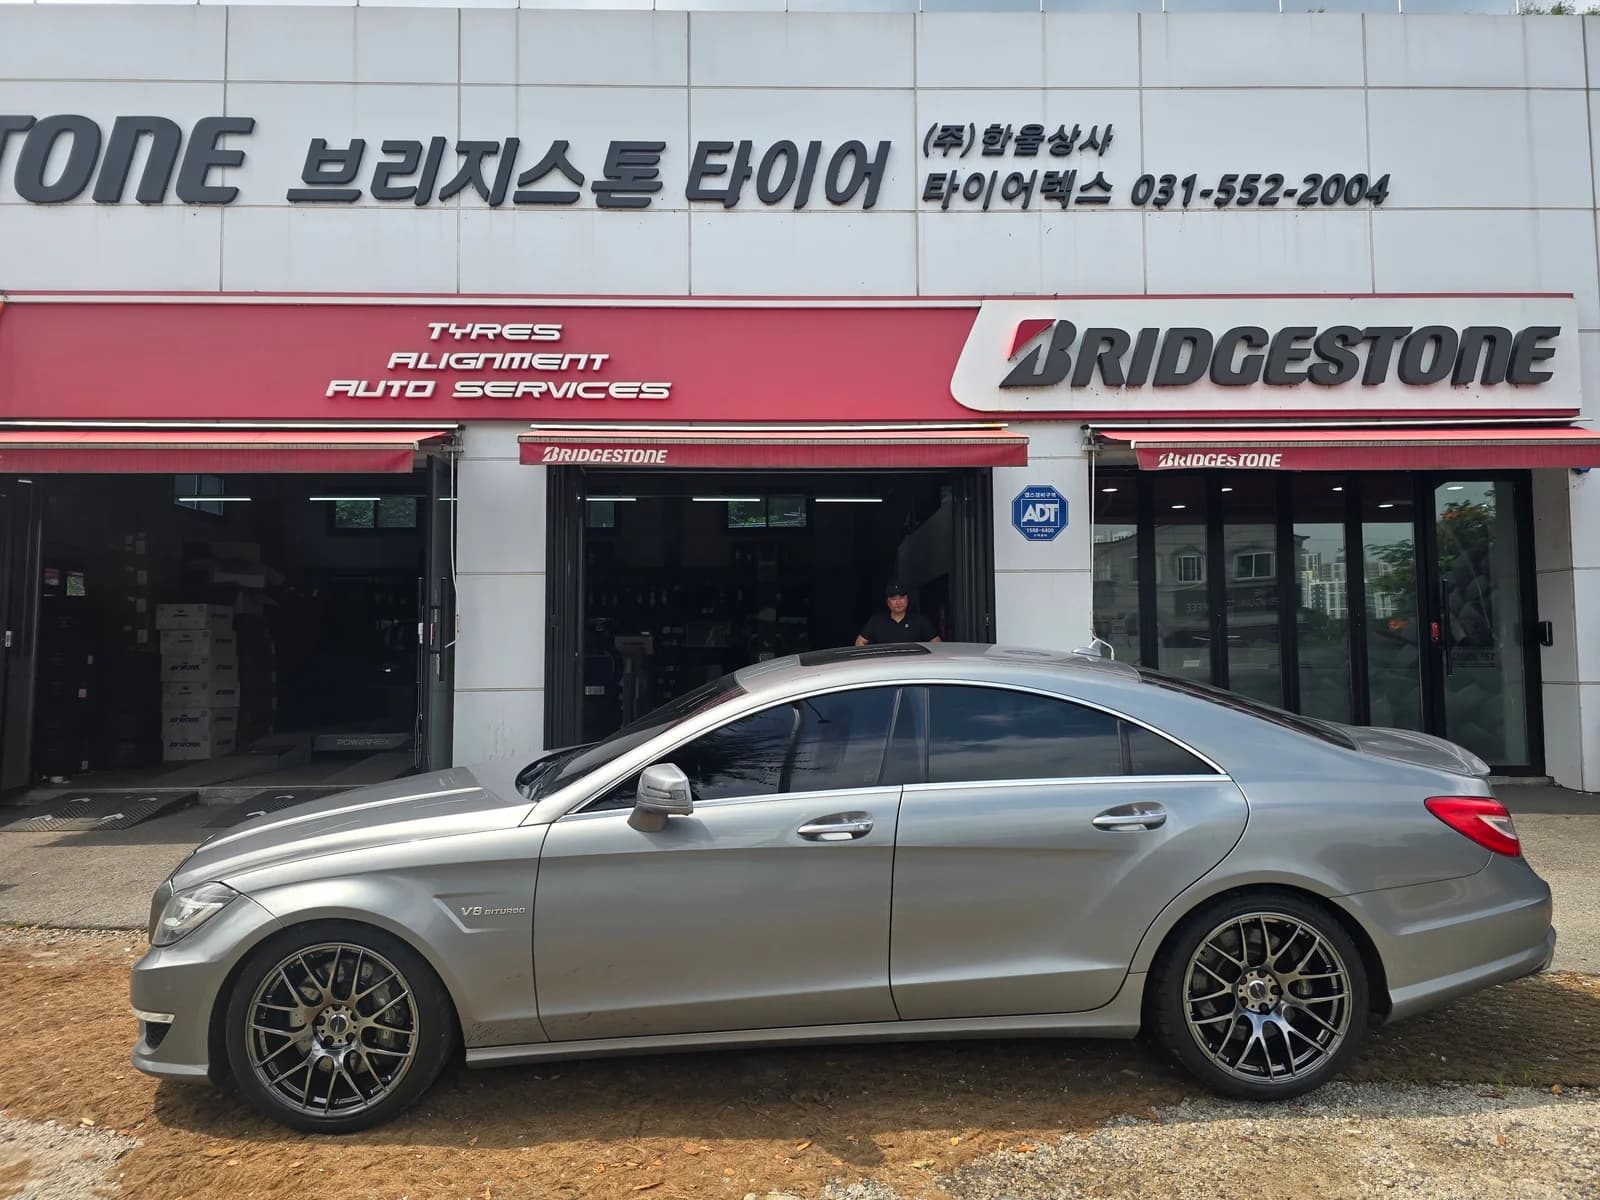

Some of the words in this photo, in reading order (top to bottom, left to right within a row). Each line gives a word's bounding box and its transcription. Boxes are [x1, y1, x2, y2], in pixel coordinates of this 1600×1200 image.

[286, 136, 667, 209] 브리지스톤
[685, 139, 892, 210] 타이어
[922, 168, 1113, 211] 타이어렉스
[1130, 172, 1391, 209] 031-552-2004
[427, 322, 563, 341] TYRES
[386, 351, 610, 371] ALIGNMENT
[999, 318, 1561, 388] BRIDGESTONE
[324, 379, 437, 398] AUTO
[451, 380, 673, 400] SERVICES
[541, 446, 668, 464] BRIDGESTONE
[1157, 451, 1282, 469] BRIDGESTONE
[1021, 503, 1060, 523] ADT
[460, 906, 483, 916] V8
